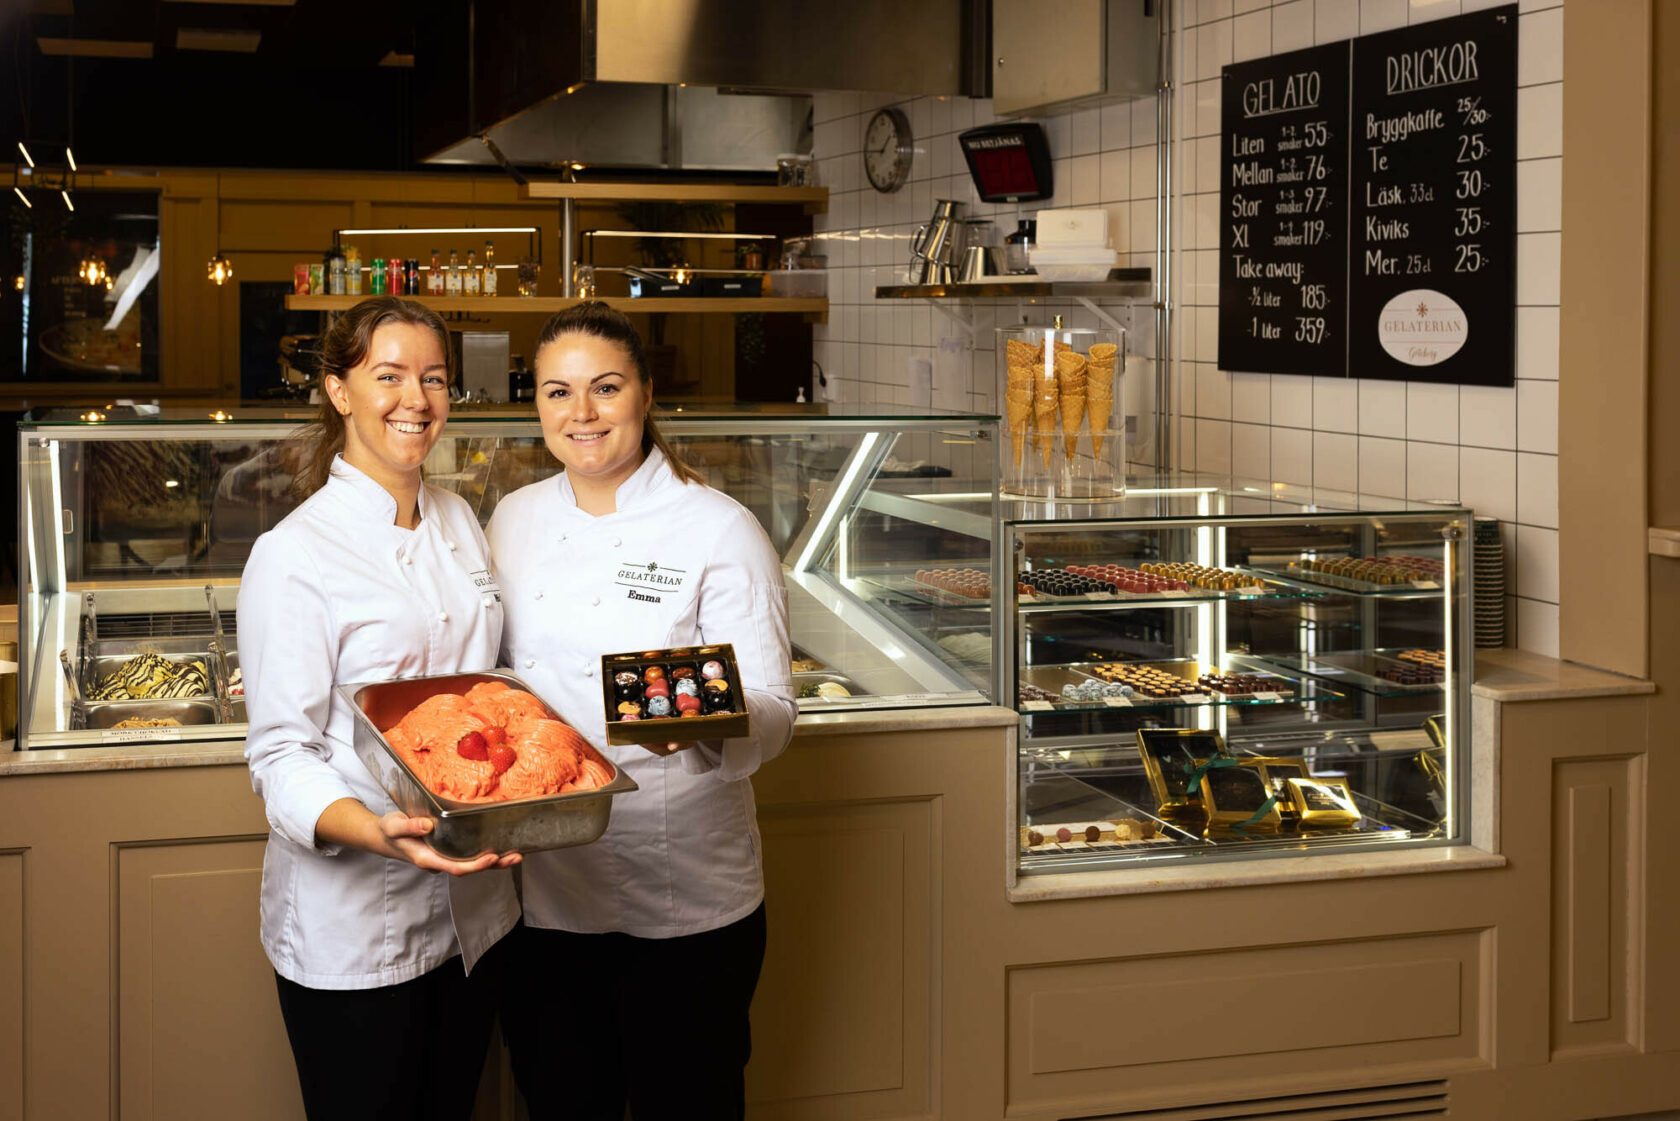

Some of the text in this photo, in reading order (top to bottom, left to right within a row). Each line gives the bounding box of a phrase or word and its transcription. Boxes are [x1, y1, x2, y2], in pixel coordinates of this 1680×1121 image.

[1387, 40, 1479, 93] DRICKOR
[1243, 71, 1321, 116] GELATO
[1366, 109, 1445, 143] Bryggkaffe
[1232, 133, 1264, 157] Liten
[1368, 146, 1389, 173] Te
[1232, 161, 1274, 187] Mellan
[1232, 193, 1262, 218] Stor
[1366, 215, 1410, 241] Kiviks
[1232, 254, 1263, 279] Take
[1383, 320, 1462, 333] GELATERIAN
[617, 569, 683, 586] GELATERIAN
[627, 589, 662, 604] Emma
